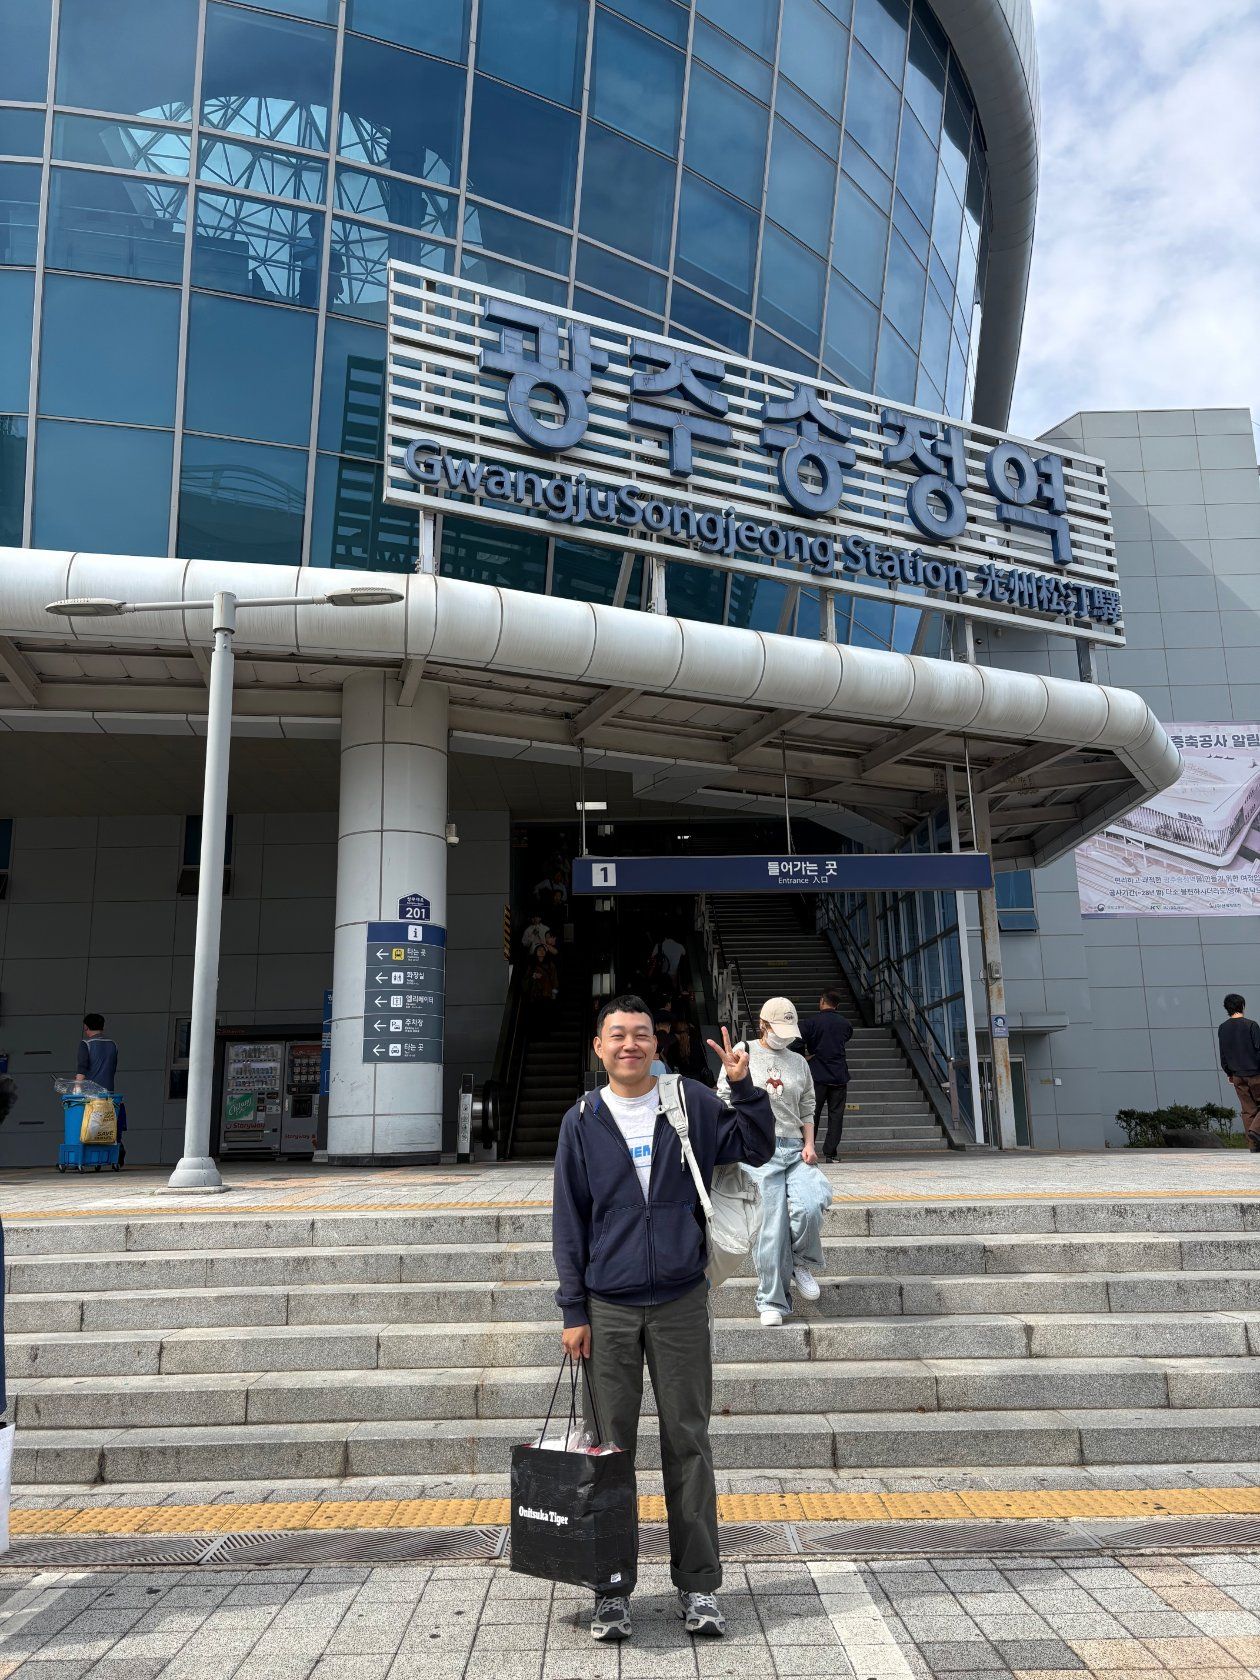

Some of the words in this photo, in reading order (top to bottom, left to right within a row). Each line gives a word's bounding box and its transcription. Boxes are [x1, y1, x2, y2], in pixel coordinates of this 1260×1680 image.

[479, 298, 1072, 565] 광주송정역
[842, 534, 969, 594] Station
[1231, 733, 1260, 747] 알림
[768, 861, 818, 875] 들어가는
[825, 861, 838, 875] 곳
[600, 866, 608, 882] 1
[1225, 874, 1239, 882] 위한
[812, 876, 828, 884] 入口
[1165, 888, 1179, 896] 다소
[406, 907, 426, 919] 201
[407, 948, 419, 956] 타는
[420, 948, 426, 956] 곳
[406, 971, 425, 980] 화장실
[404, 1018, 424, 1027] 주차장
[404, 1043, 417, 1052] 타는
[417, 1043, 424, 1052] 곳
[518, 1505, 549, 1521] Onitsuka
[549, 1511, 568, 1526] Tiger
